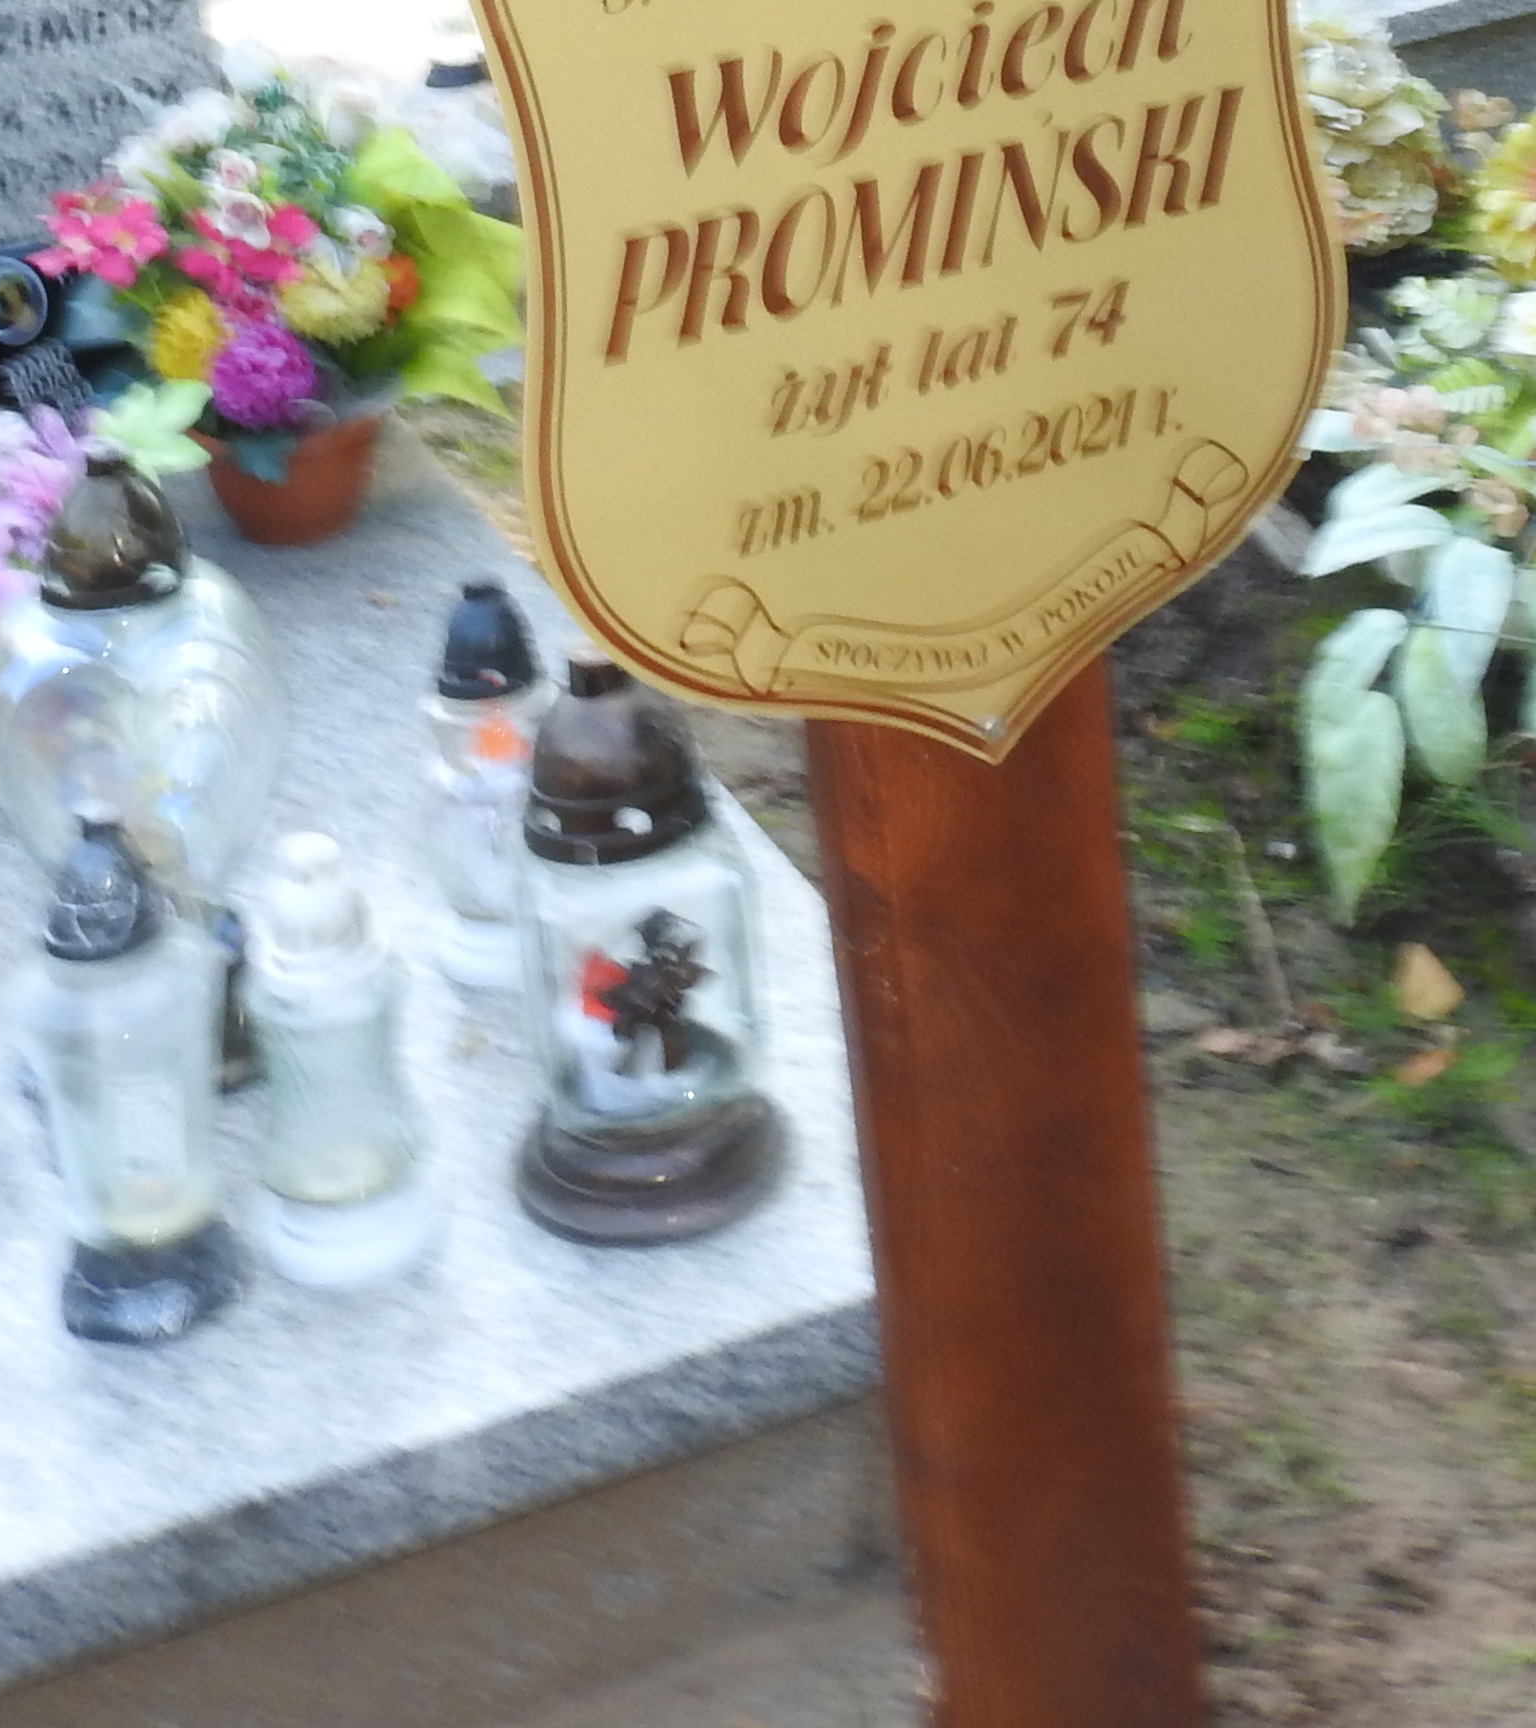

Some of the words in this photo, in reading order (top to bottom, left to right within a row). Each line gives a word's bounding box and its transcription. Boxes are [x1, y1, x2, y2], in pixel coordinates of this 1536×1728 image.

[604, 86, 1245, 365] PROMIŃSKI
[917, 315, 1018, 395] lat
[1049, 279, 1130, 360] 74
[738, 490, 836, 559] zm.
[857, 388, 1138, 524] 22.06.2021
[817, 635, 989, 672] SPOCZYWAJ
[1000, 630, 1026, 655] W
[1039, 541, 1146, 635] POKOJU
